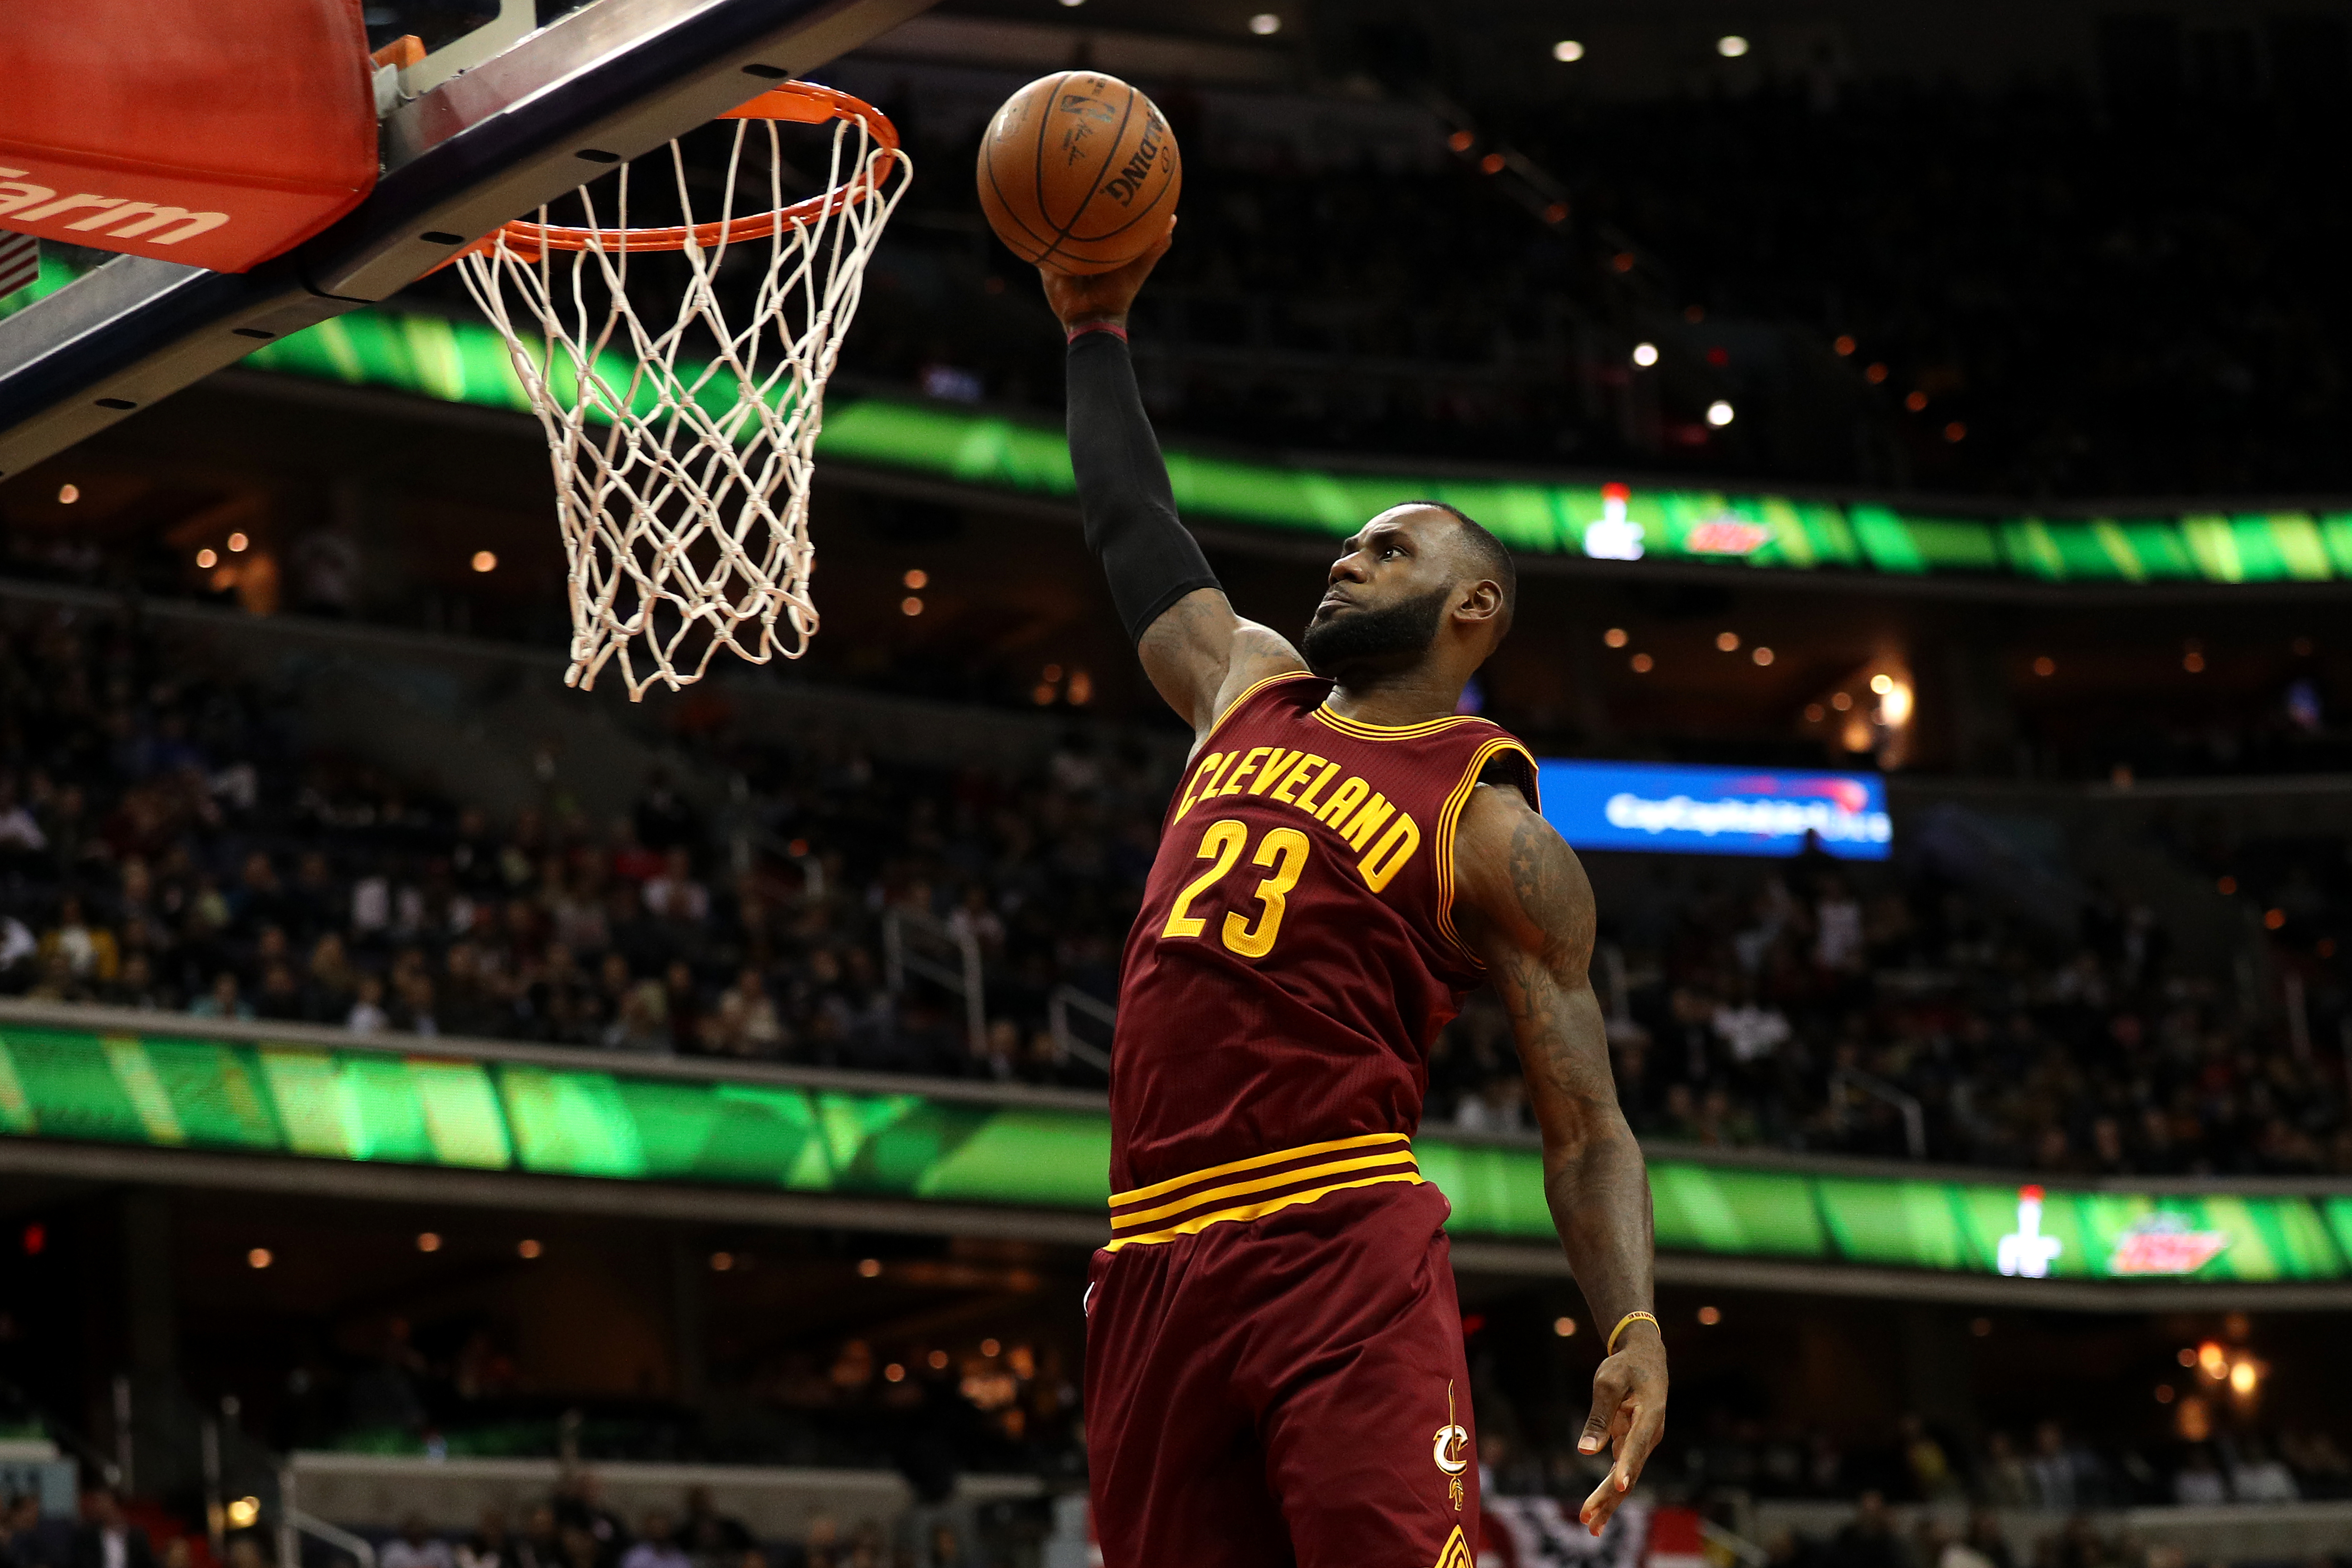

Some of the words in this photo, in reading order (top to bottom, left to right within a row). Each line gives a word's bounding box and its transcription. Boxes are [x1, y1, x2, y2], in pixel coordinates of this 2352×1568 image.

[0, 167, 230, 245] arm
[1161, 819, 1310, 958] 23
[1173, 747, 1421, 894] CLEVELAND
